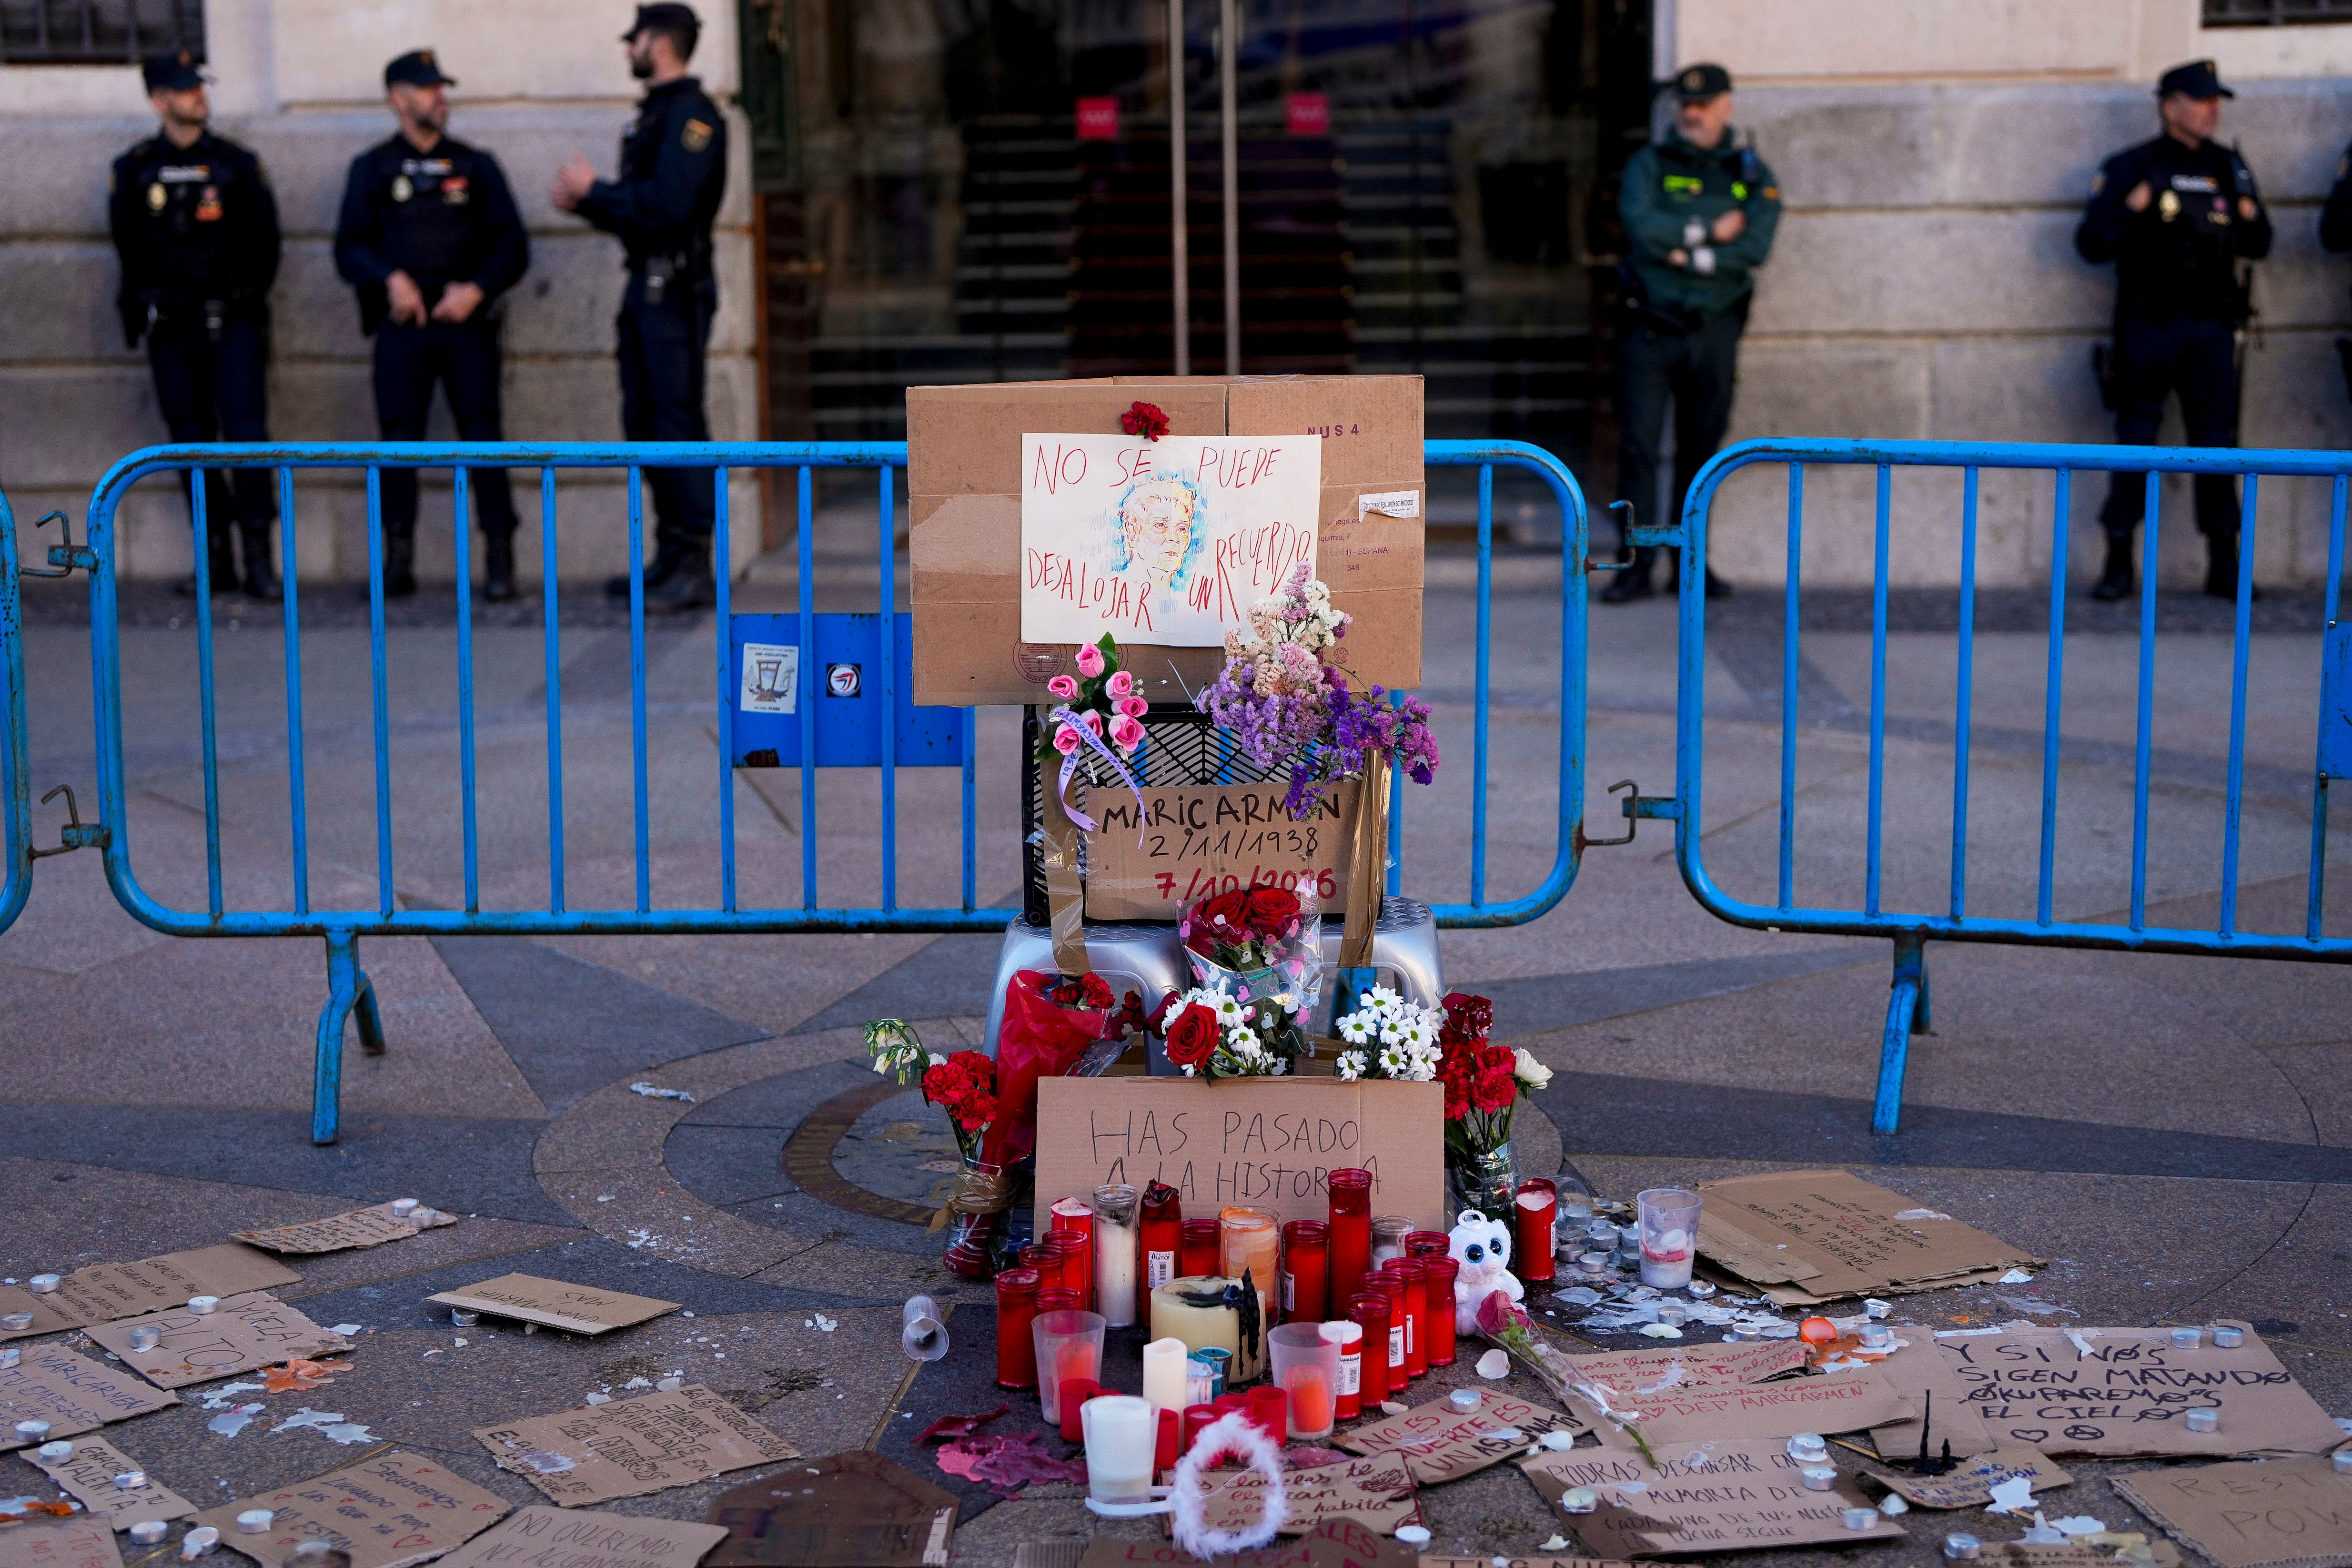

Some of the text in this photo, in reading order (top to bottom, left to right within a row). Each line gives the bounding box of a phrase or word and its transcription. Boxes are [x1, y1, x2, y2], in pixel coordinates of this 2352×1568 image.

[1351, 424, 1359, 435] 4
[1033, 444, 1282, 495] NO SE PUEDE
[1318, 534, 1345, 543] lquimia,
[1028, 547, 1153, 632] DESALOJAR
[1188, 571, 1214, 611] UN
[1101, 793, 1341, 835] MARICARMN
[1090, 1109, 1359, 1164] HAS PASADO
[1216, 1154, 1382, 1202] HISTORA
[1745, 1203, 1873, 1266] CAMBIASTE PARA SIEMPRE
[1812, 1214, 1896, 1254] CORAZONES DE
[1864, 1250, 1889, 1262] LAS
[100, 1283, 136, 1301] DORMIDO
[146, 1259, 200, 1294] GRACIAS POR
[224, 1300, 304, 1343] VUELA
[1587, 1371, 1627, 1382] ngre
[1692, 1368, 1712, 1378] y
[1743, 1345, 1802, 1373] alma
[1940, 1342, 1976, 1364] Y
[1995, 1344, 2046, 1363] SI
[30, 1355, 154, 1411] MARICARMEN
[1957, 1366, 2079, 1384] SIGEN
[680, 1388, 706, 1400] LA
[1628, 1395, 1685, 1405] todos
[1693, 1387, 1779, 1399] nuestros
[1672, 1385, 1863, 1416] DEP MARICARMEN
[656, 1403, 721, 1439] TIENE
[1359, 1391, 1502, 1450] NO ES UA
[1492, 1402, 1532, 1423] ES
[1980, 1405, 2024, 1420] EL
[599, 1402, 712, 1457] SANGRE
[683, 1459, 717, 1472] EN
[505, 1453, 520, 1461] LA
[540, 1478, 568, 1494] SIGUE
[1346, 1462, 1375, 1477] te
[1423, 1448, 1480, 1472] UN
[1546, 1452, 1800, 1487] PODRAS DESCANSAR EN
[363, 1461, 463, 1509] SEGUIREMOS
[1600, 1486, 1807, 1508] LA MEMORIA DE
[2170, 1472, 2316, 1498] REST
[297, 1489, 332, 1503] LAS
[336, 1506, 370, 1519] QUE
[320, 1477, 431, 1531] LUCHANDO POR
[1313, 1499, 1393, 1513] habita
[509, 1513, 682, 1555] NO QUEREMOS
[1604, 1515, 1661, 1530] CADA
[1669, 1514, 1709, 1525] UNO
[1718, 1513, 1753, 1524] DE
[475, 1542, 528, 1561] NI
[1621, 1526, 1798, 1551] LA LUCHA SIGUE
